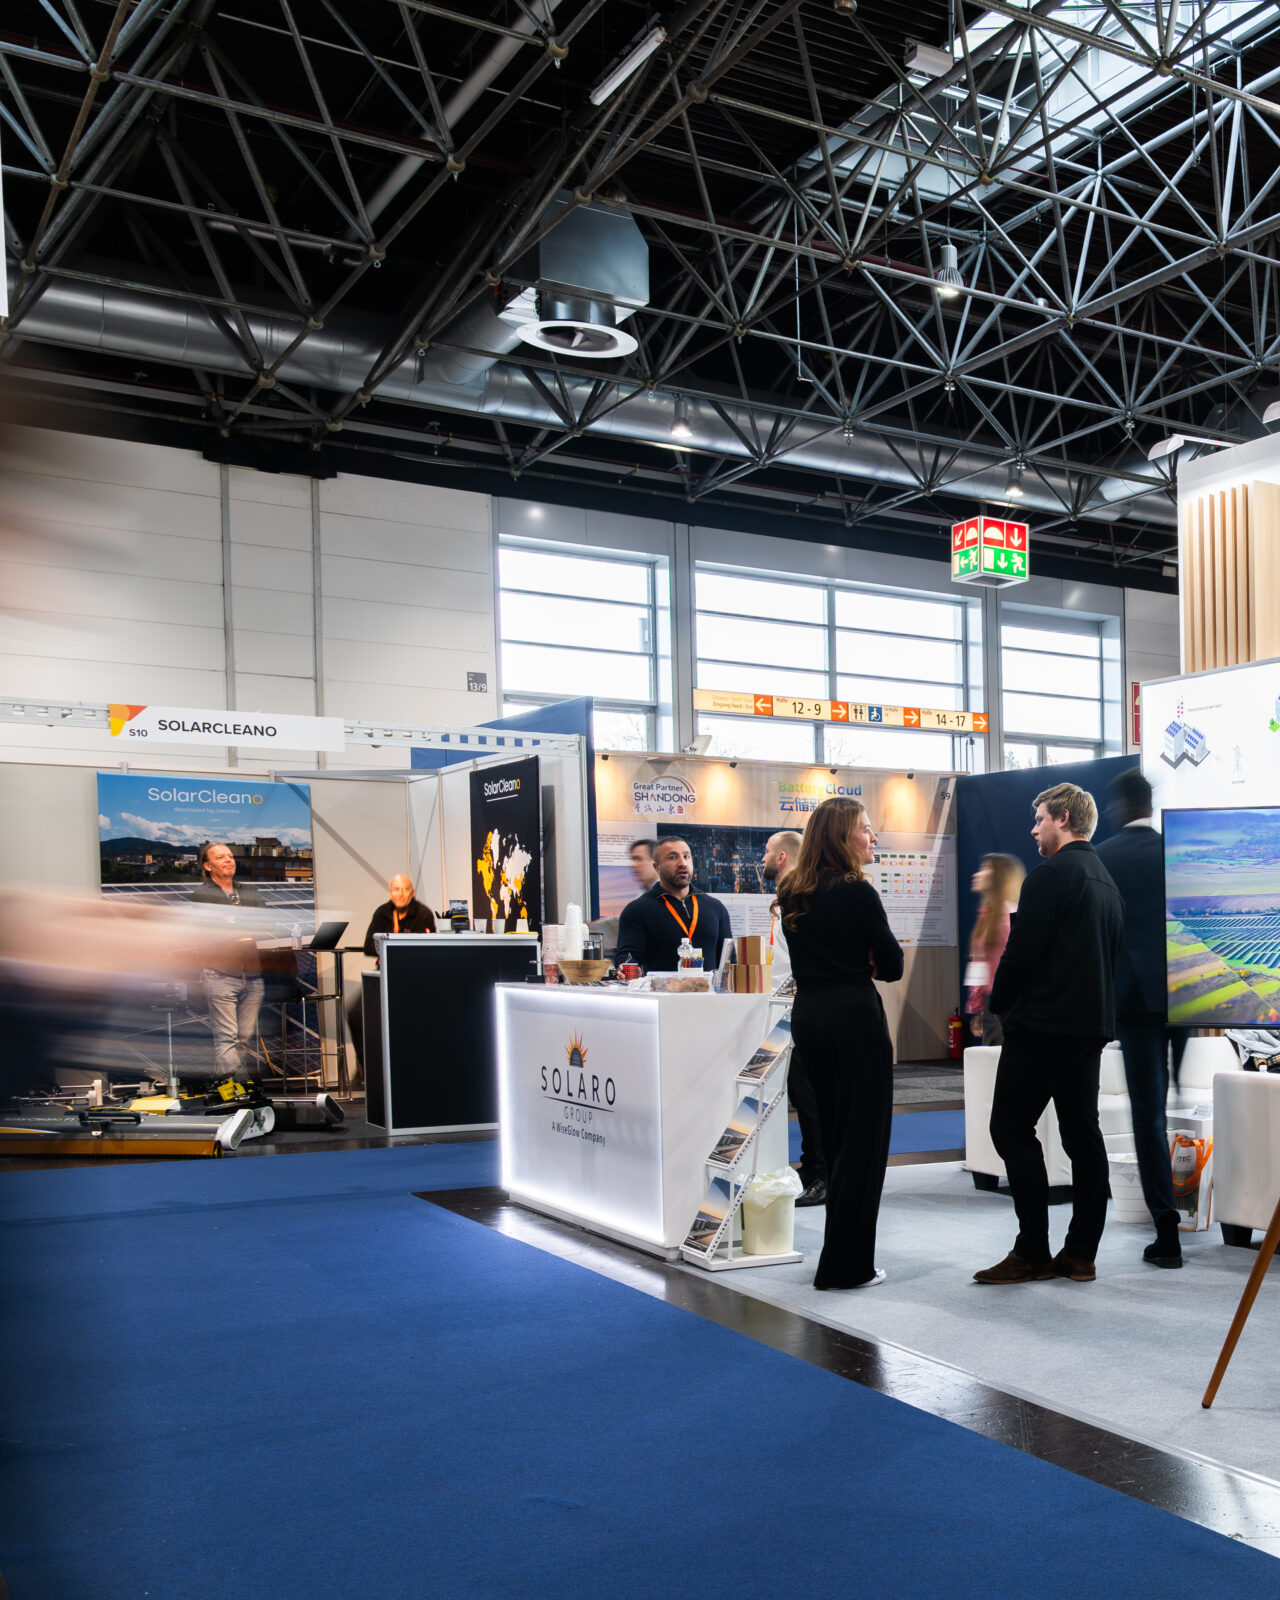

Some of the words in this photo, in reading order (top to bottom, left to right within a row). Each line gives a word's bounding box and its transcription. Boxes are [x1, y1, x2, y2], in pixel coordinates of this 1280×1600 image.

[792, 702, 804, 714] 12
[814, 703, 821, 715] 9
[158, 719, 277, 737] SOLARCLEANO
[936, 714, 947, 725] 14
[955, 715, 965, 727] 17
[129, 728, 148, 738] S10
[484, 778, 520, 796] SolarCleano
[634, 782, 654, 791] Great
[656, 784, 683, 792] Partner
[148, 787, 264, 805] SolarCleano
[634, 792, 696, 804] SHANDONG
[941, 791, 951, 800] S9
[541, 1065, 616, 1105] SOLARO
[564, 1105, 593, 1124] GROUP
[556, 1122, 580, 1138] WiseGlow
[581, 1128, 606, 1147] Company
